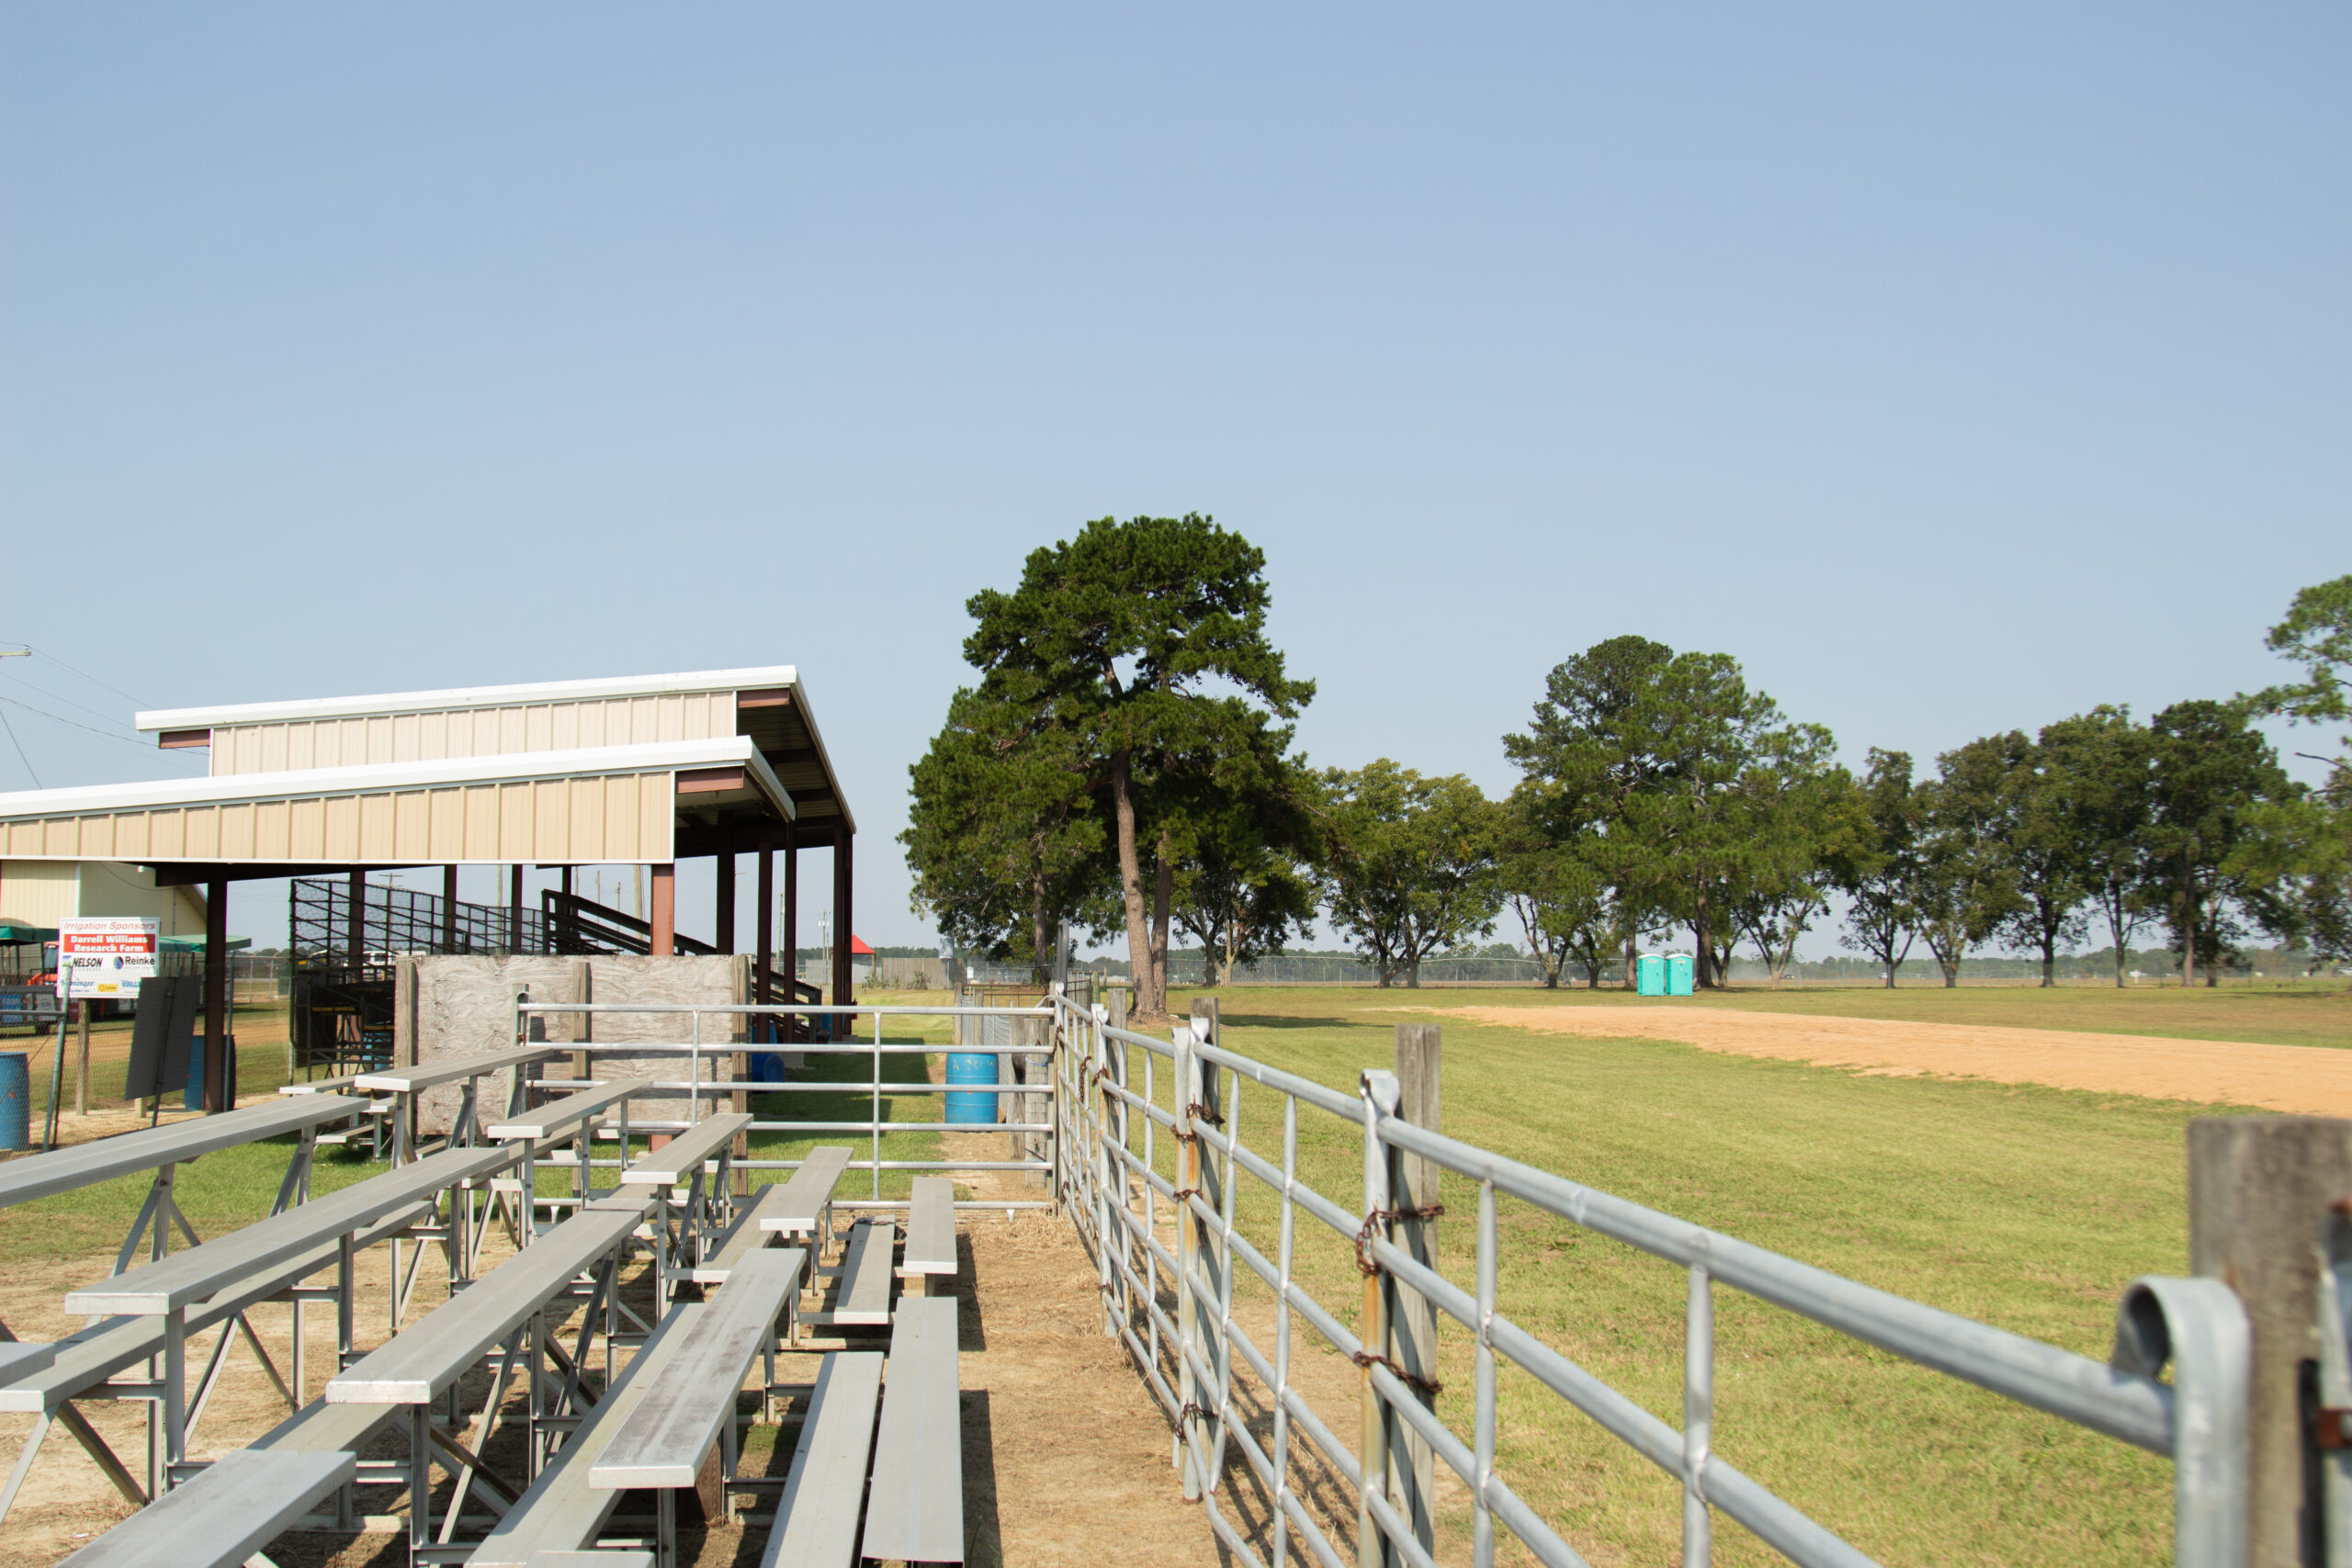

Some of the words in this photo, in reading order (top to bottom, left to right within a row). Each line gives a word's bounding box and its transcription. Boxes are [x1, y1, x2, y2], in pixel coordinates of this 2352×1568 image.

[64, 922, 107, 931] Irrigation
[109, 921, 155, 931] Sponsors
[71, 935, 103, 943] Darrell
[106, 935, 147, 943] Williams
[73, 958, 103, 967] NELSON
[125, 956, 155, 965] Reinke
